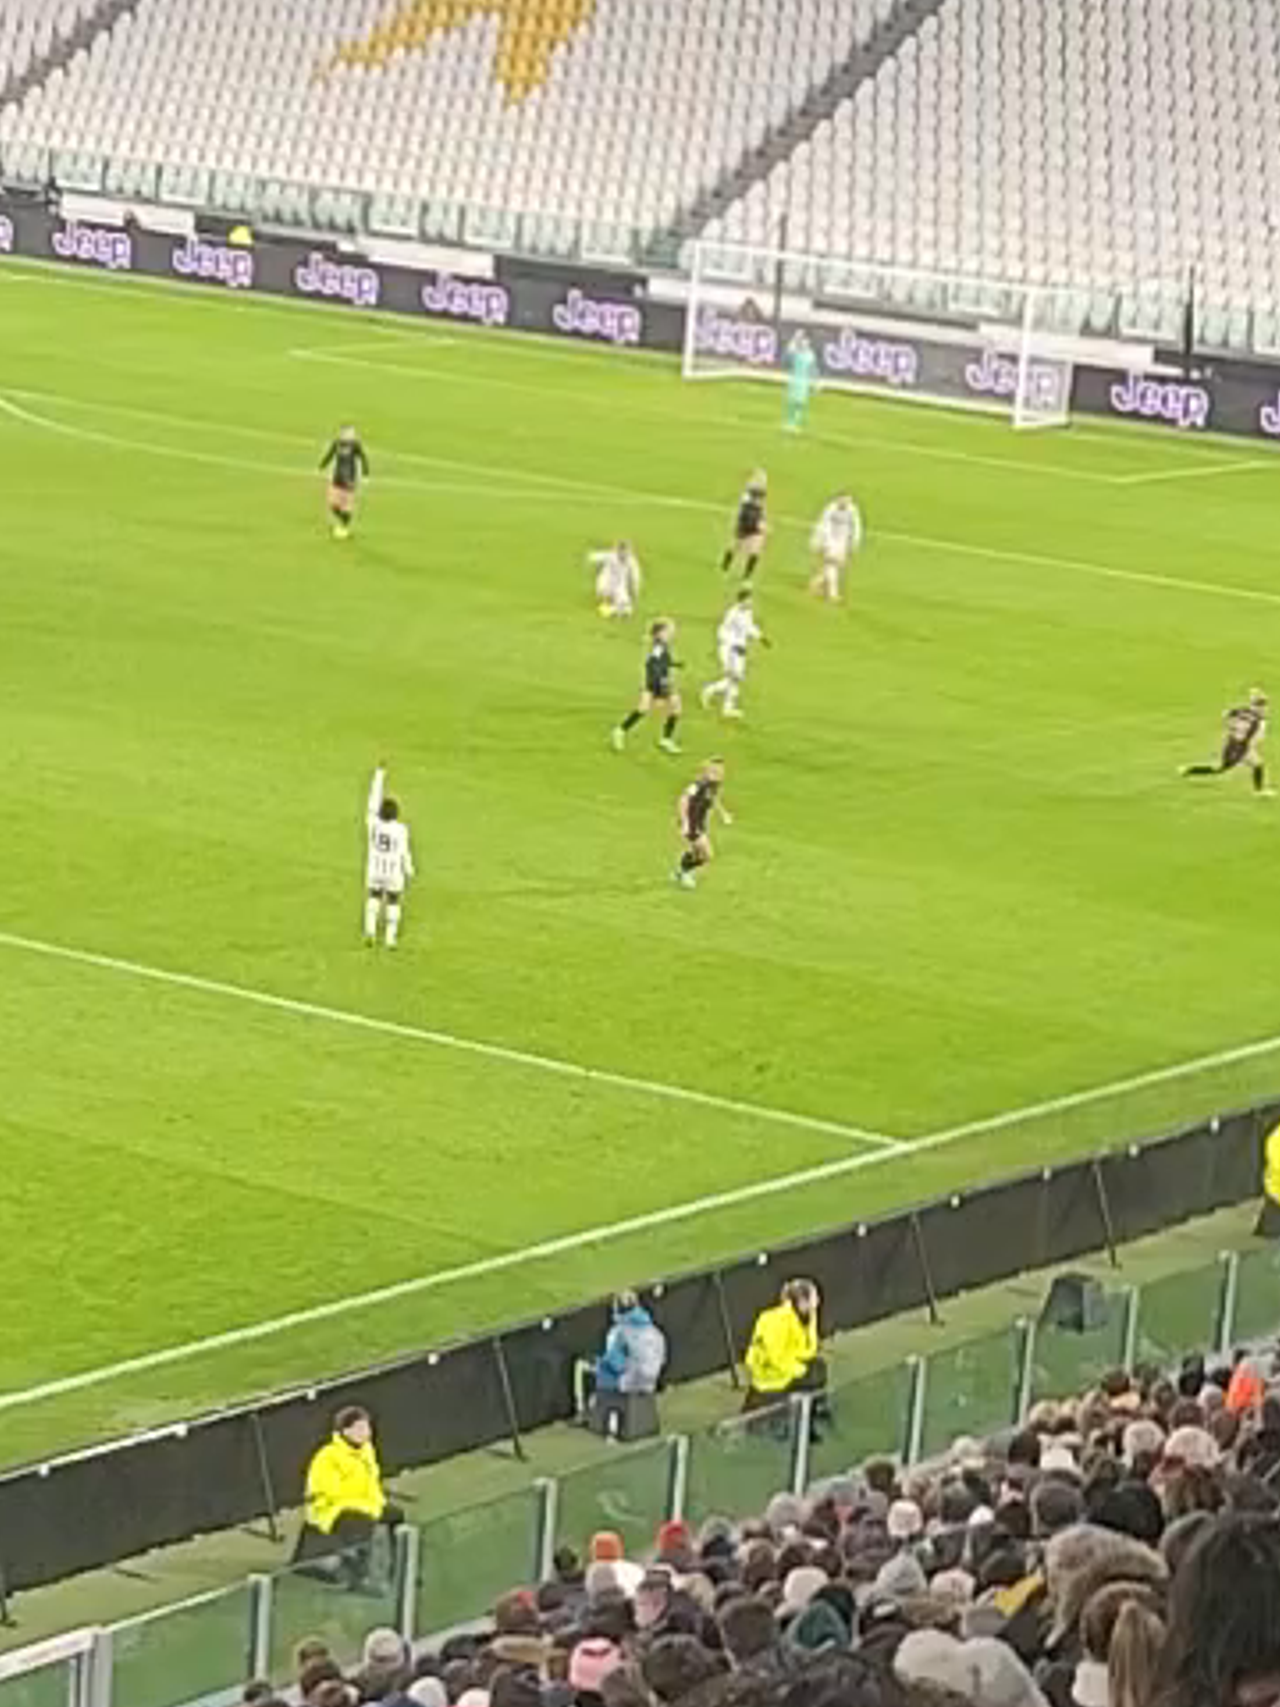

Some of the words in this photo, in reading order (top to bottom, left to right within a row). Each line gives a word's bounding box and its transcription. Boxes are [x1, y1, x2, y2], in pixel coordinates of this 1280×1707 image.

[52, 219, 132, 269] Jeep
[172, 235, 254, 287] Jeep
[295, 251, 380, 304] Jeep
[422, 272, 510, 324] Jeep
[553, 289, 641, 343] Jeep
[825, 326, 917, 383] Jeep
[1111, 374, 1208, 426] Jeep
